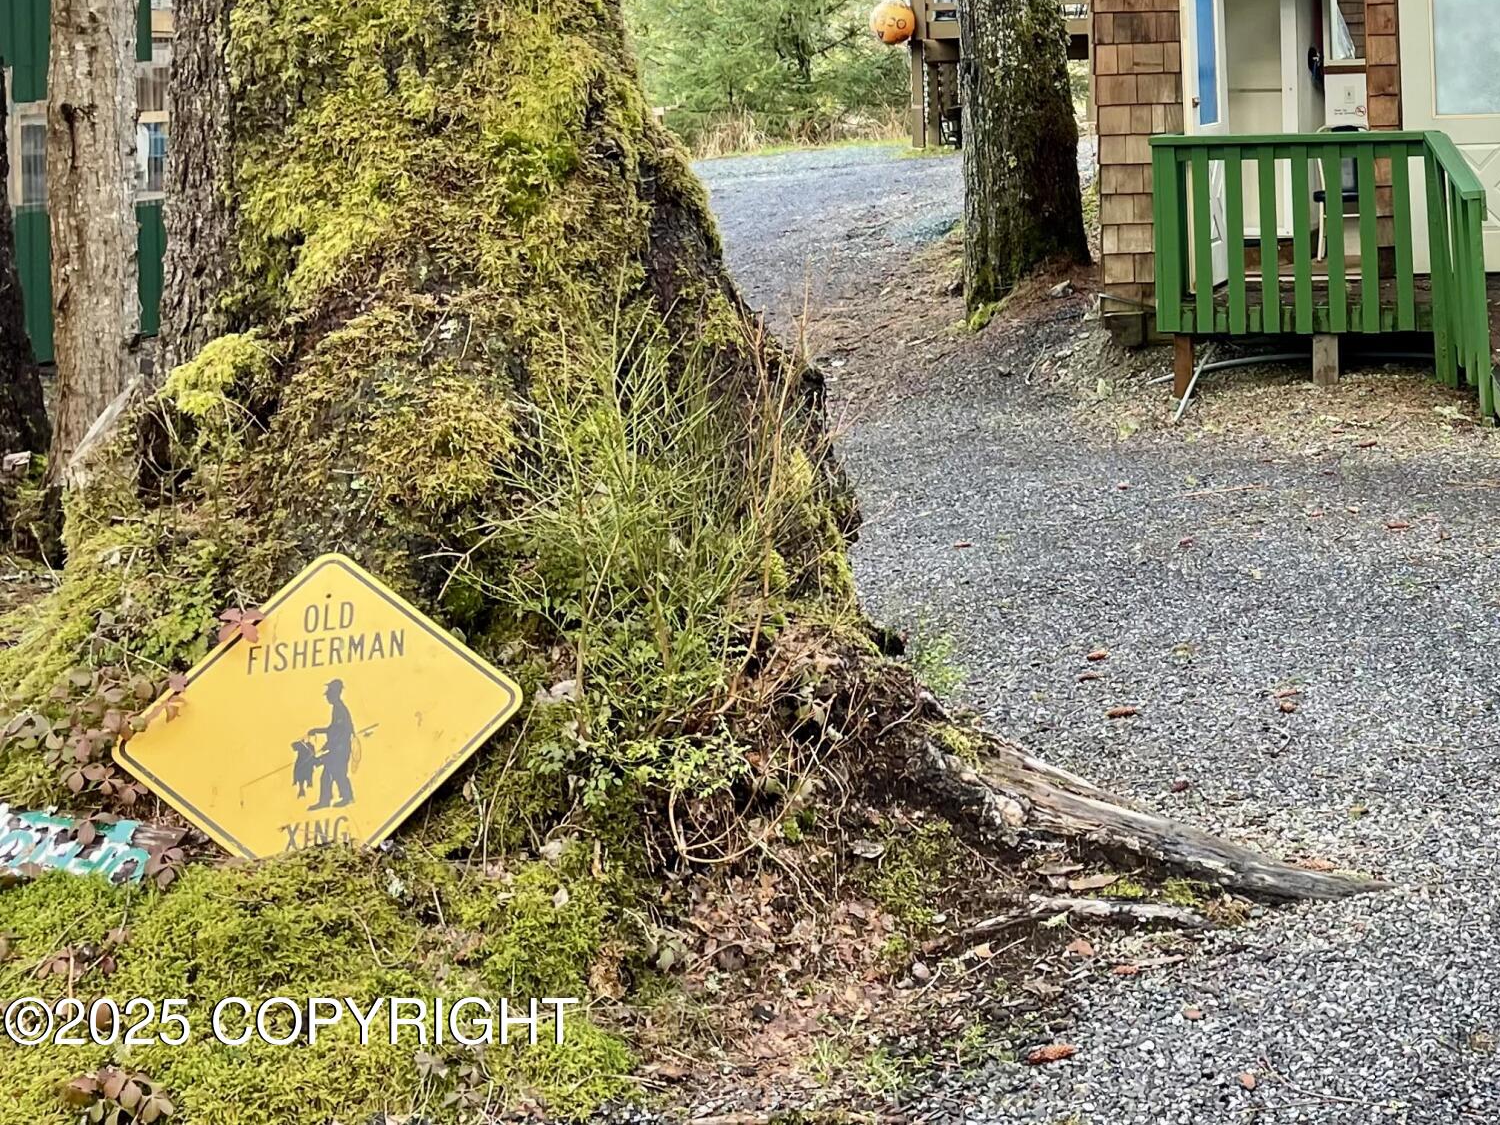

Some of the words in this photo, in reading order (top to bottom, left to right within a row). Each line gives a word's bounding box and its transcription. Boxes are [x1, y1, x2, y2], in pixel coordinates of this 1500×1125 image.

[304, 602, 354, 634] OLD
[247, 629, 405, 675] FISHERMAN
[285, 816, 352, 852] XING
